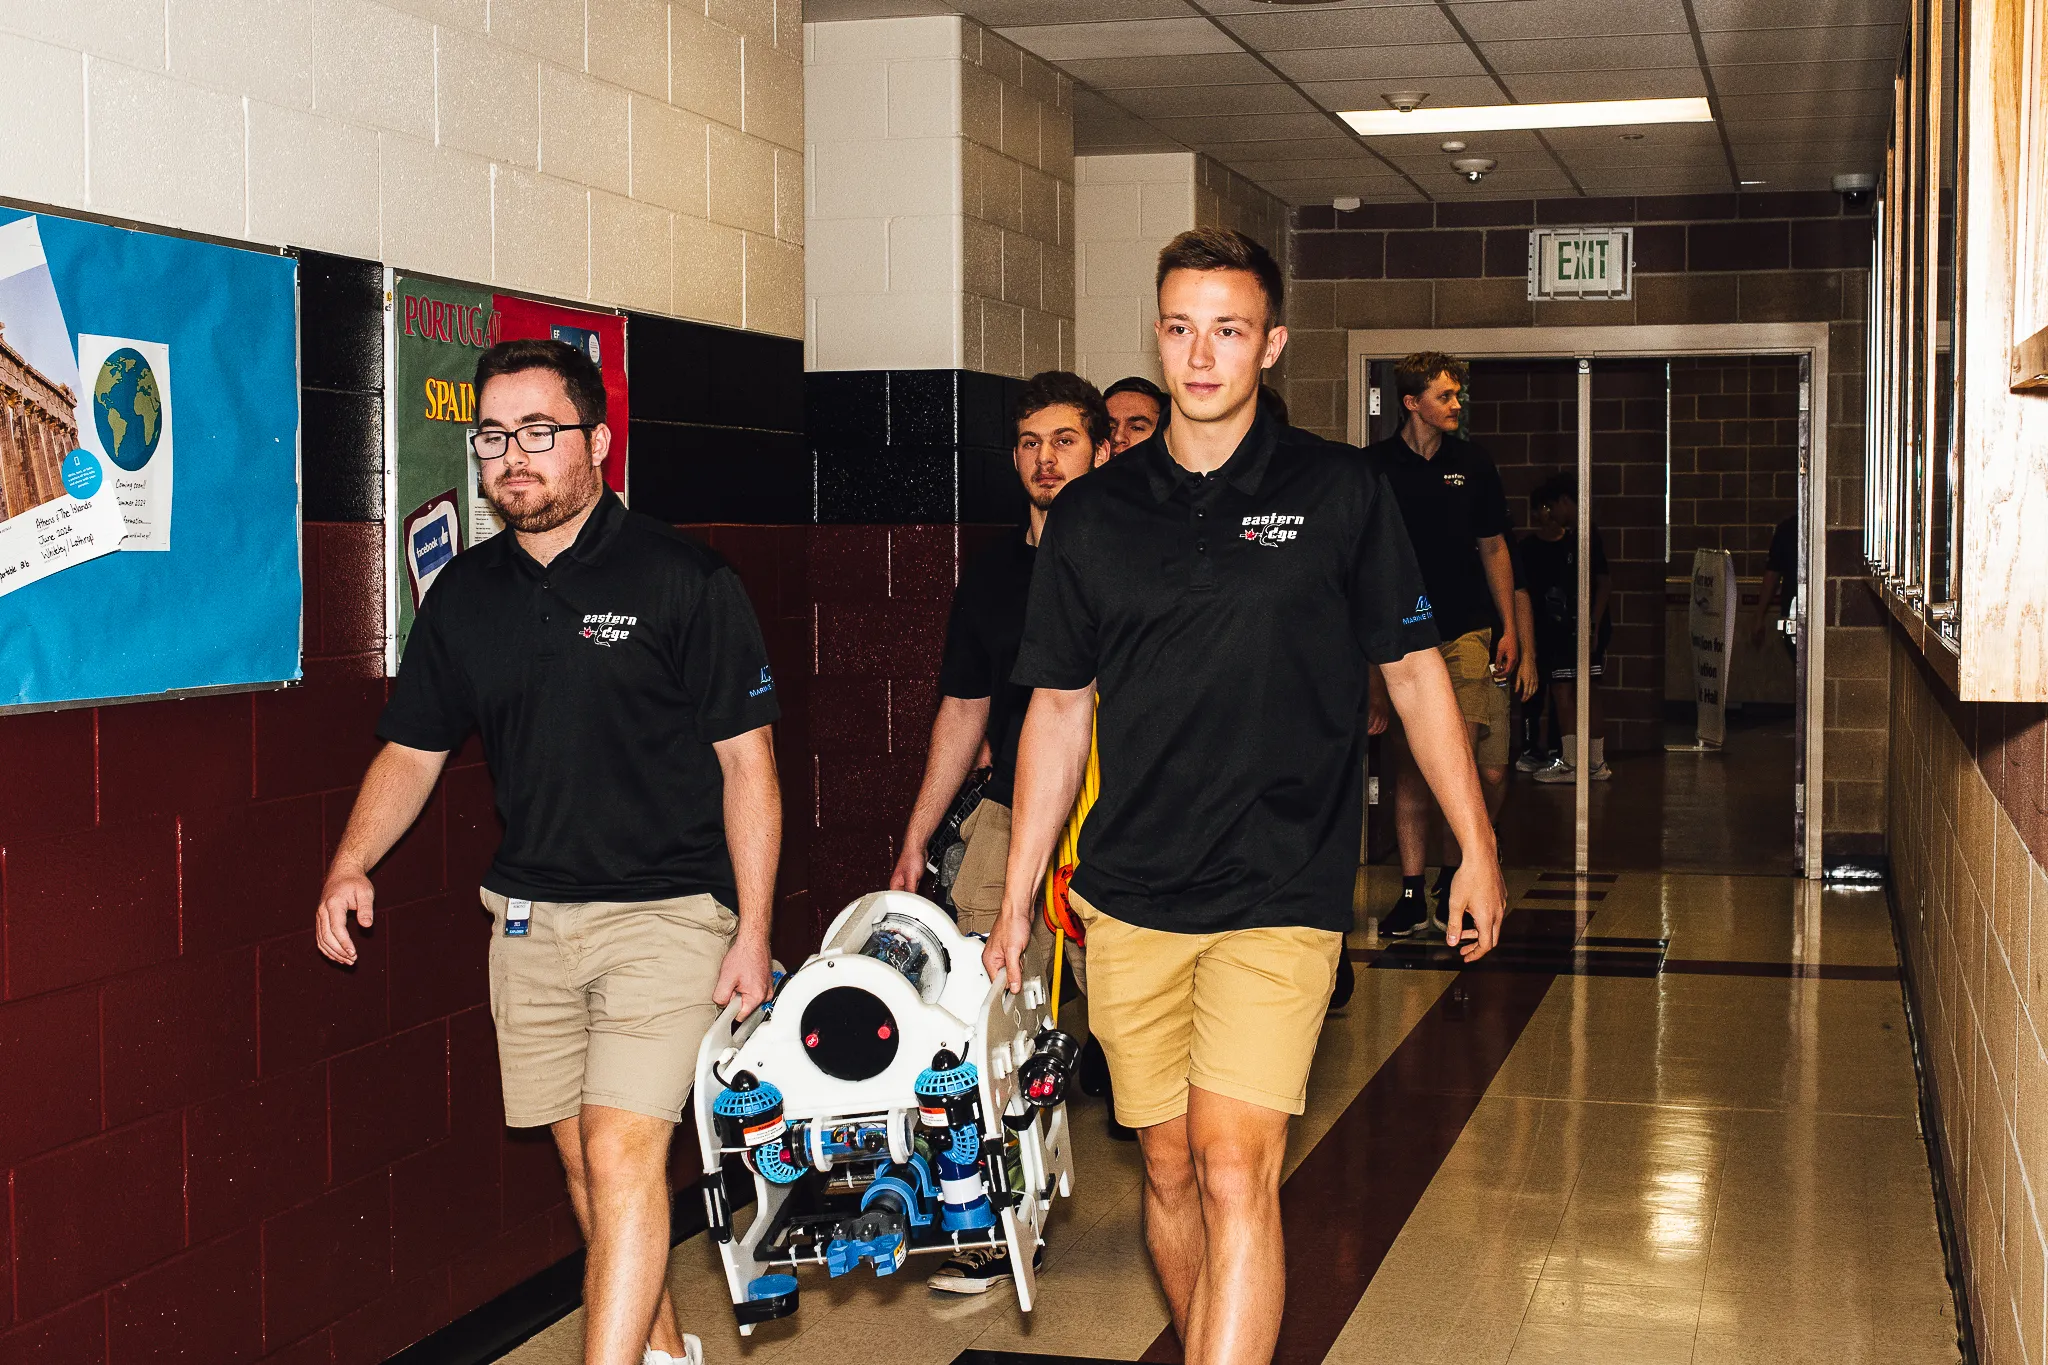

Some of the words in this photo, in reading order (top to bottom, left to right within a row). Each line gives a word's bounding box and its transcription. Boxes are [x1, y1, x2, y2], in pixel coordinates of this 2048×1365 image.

[1558, 240, 1609, 280] EXIT
[553, 329, 560, 339] EF
[1241, 512, 1304, 525] eastern
[416, 536, 439, 559] facebook
[582, 611, 637, 626] eastern
[807, 1036, 817, 1046] OK
